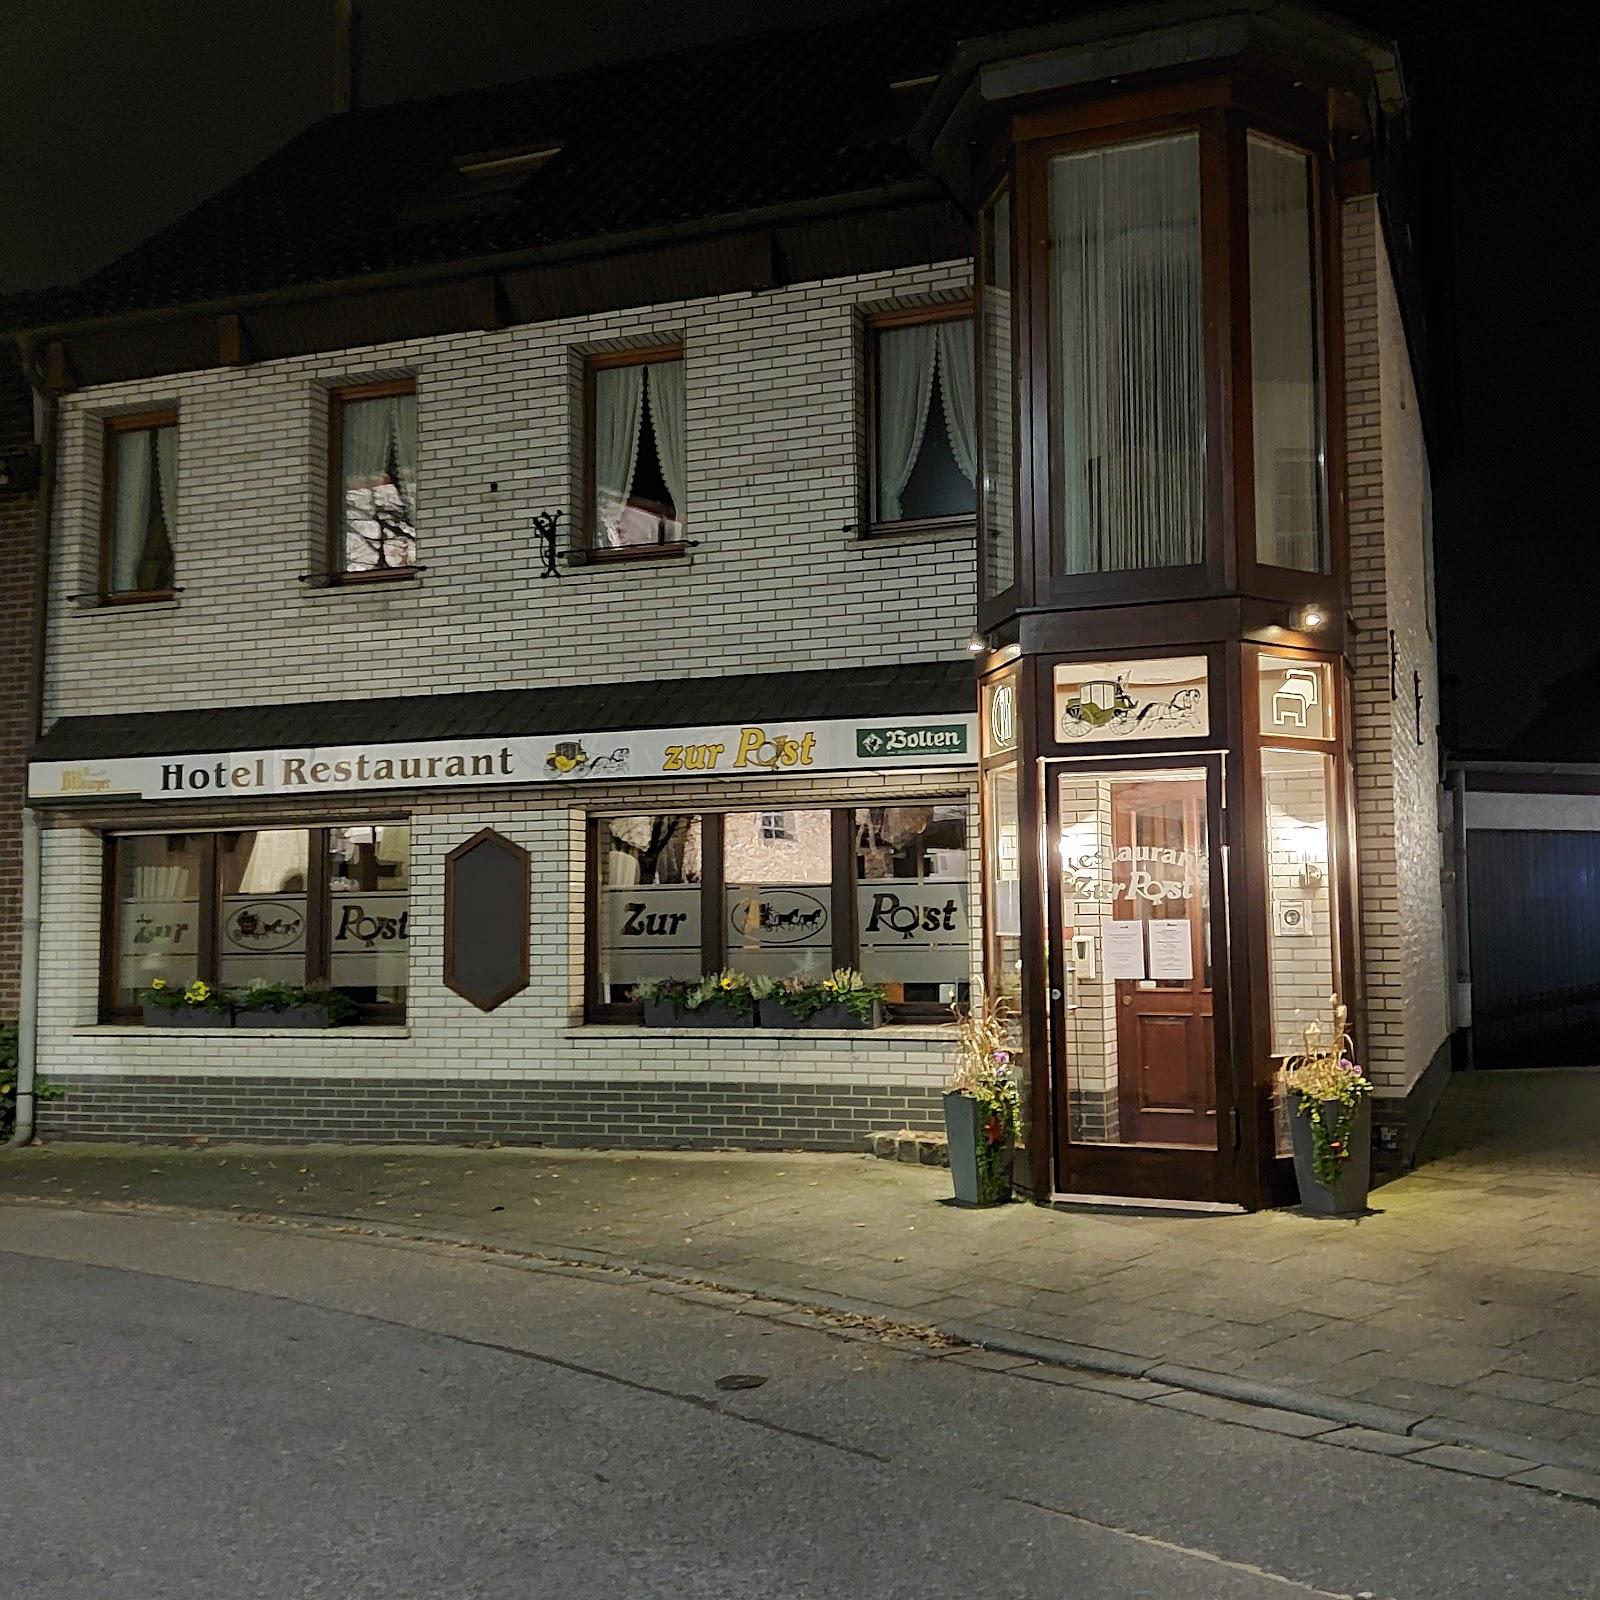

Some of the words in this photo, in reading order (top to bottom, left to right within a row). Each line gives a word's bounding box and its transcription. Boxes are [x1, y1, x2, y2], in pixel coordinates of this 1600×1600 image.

[886, 729, 962, 750] Bolten
[161, 759, 265, 791] Hotel
[282, 747, 514, 786] Restaurant
[662, 743, 725, 771] zur
[734, 727, 818, 771] Post
[1068, 846, 1201, 873] estauran
[1072, 876, 1126, 901] Zur
[1124, 871, 1194, 906] Post
[335, 905, 409, 947] Post
[622, 902, 688, 937] Zur
[866, 892, 958, 939] Post
